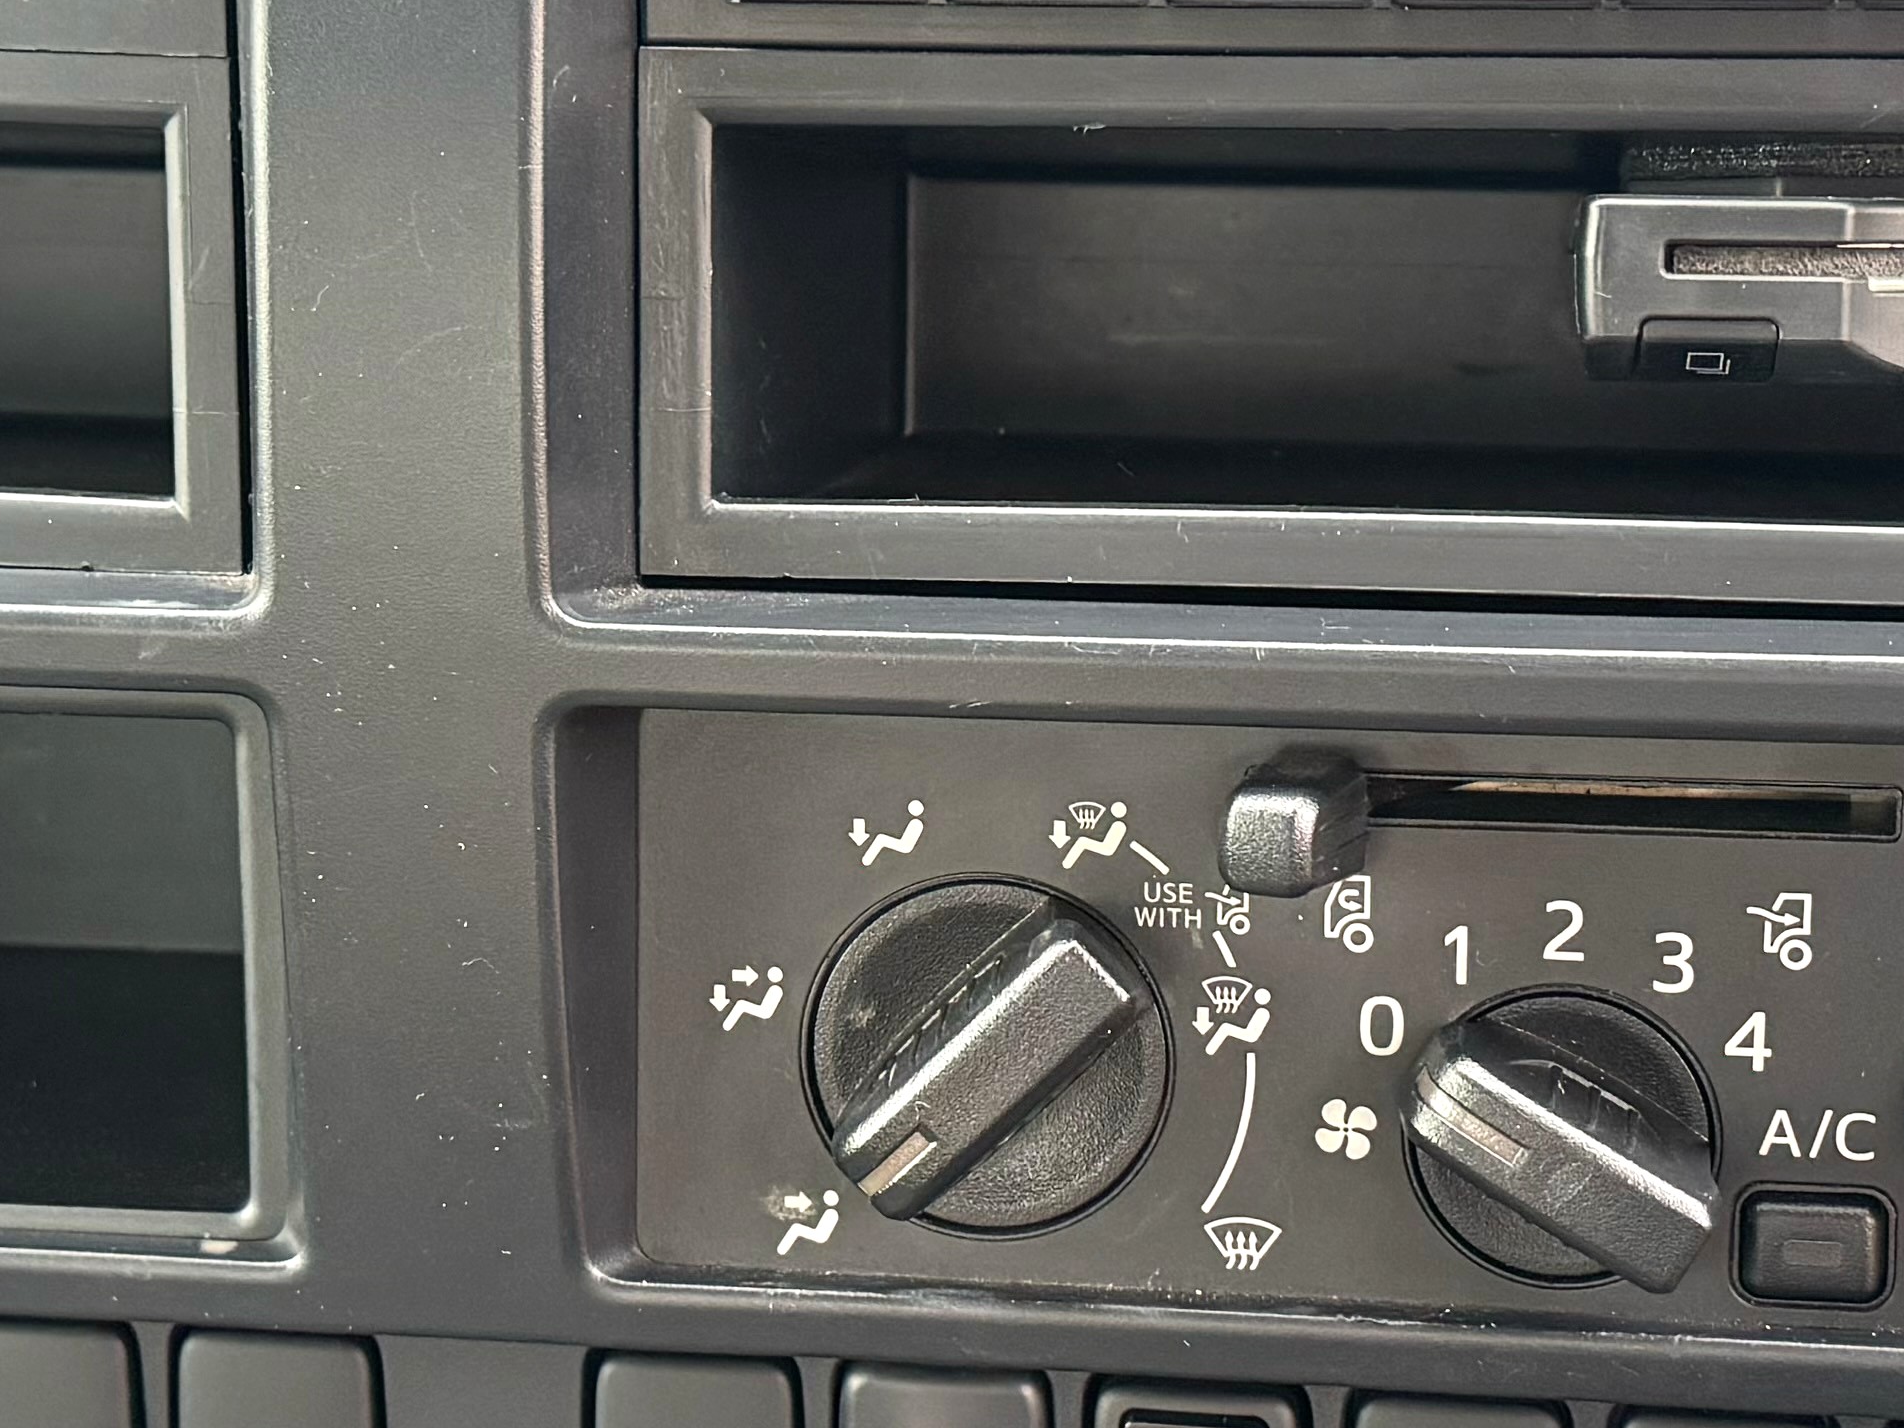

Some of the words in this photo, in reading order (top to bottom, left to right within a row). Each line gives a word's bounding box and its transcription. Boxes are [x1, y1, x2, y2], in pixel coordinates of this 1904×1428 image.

[1133, 906, 1202, 929] WITH
[1143, 882, 1194, 905] USE
[1443, 925, 1469, 984] 1
[1544, 901, 1585, 962] 2
[1652, 932, 1696, 993] 3
[1358, 996, 1404, 1057] 0
[1724, 1012, 1772, 1071] 4
[1758, 1109, 1877, 1162] A/C
